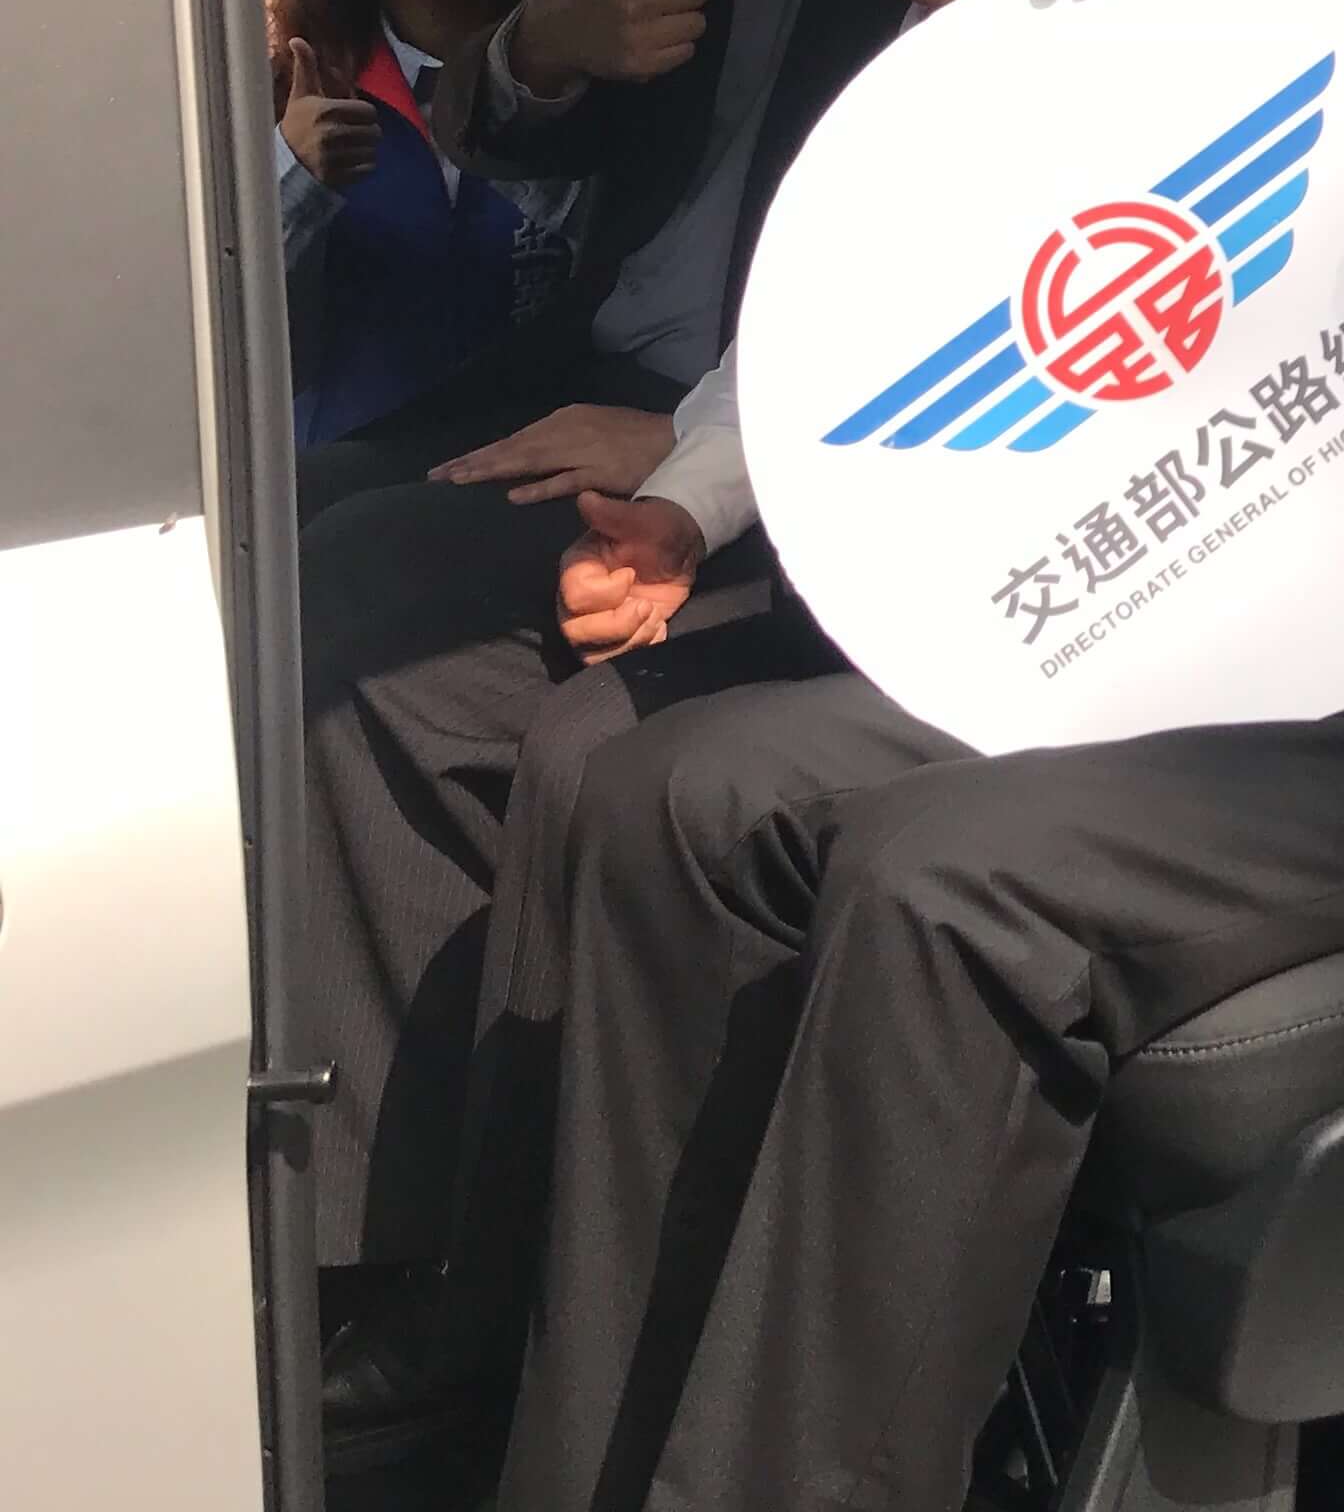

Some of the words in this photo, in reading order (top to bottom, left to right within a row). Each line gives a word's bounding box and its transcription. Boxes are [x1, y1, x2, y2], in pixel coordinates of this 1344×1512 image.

[1039, 559, 1188, 679] DIRECTORATE
[1188, 485, 1289, 565] GENERAL
[1288, 455, 1319, 486] OF
